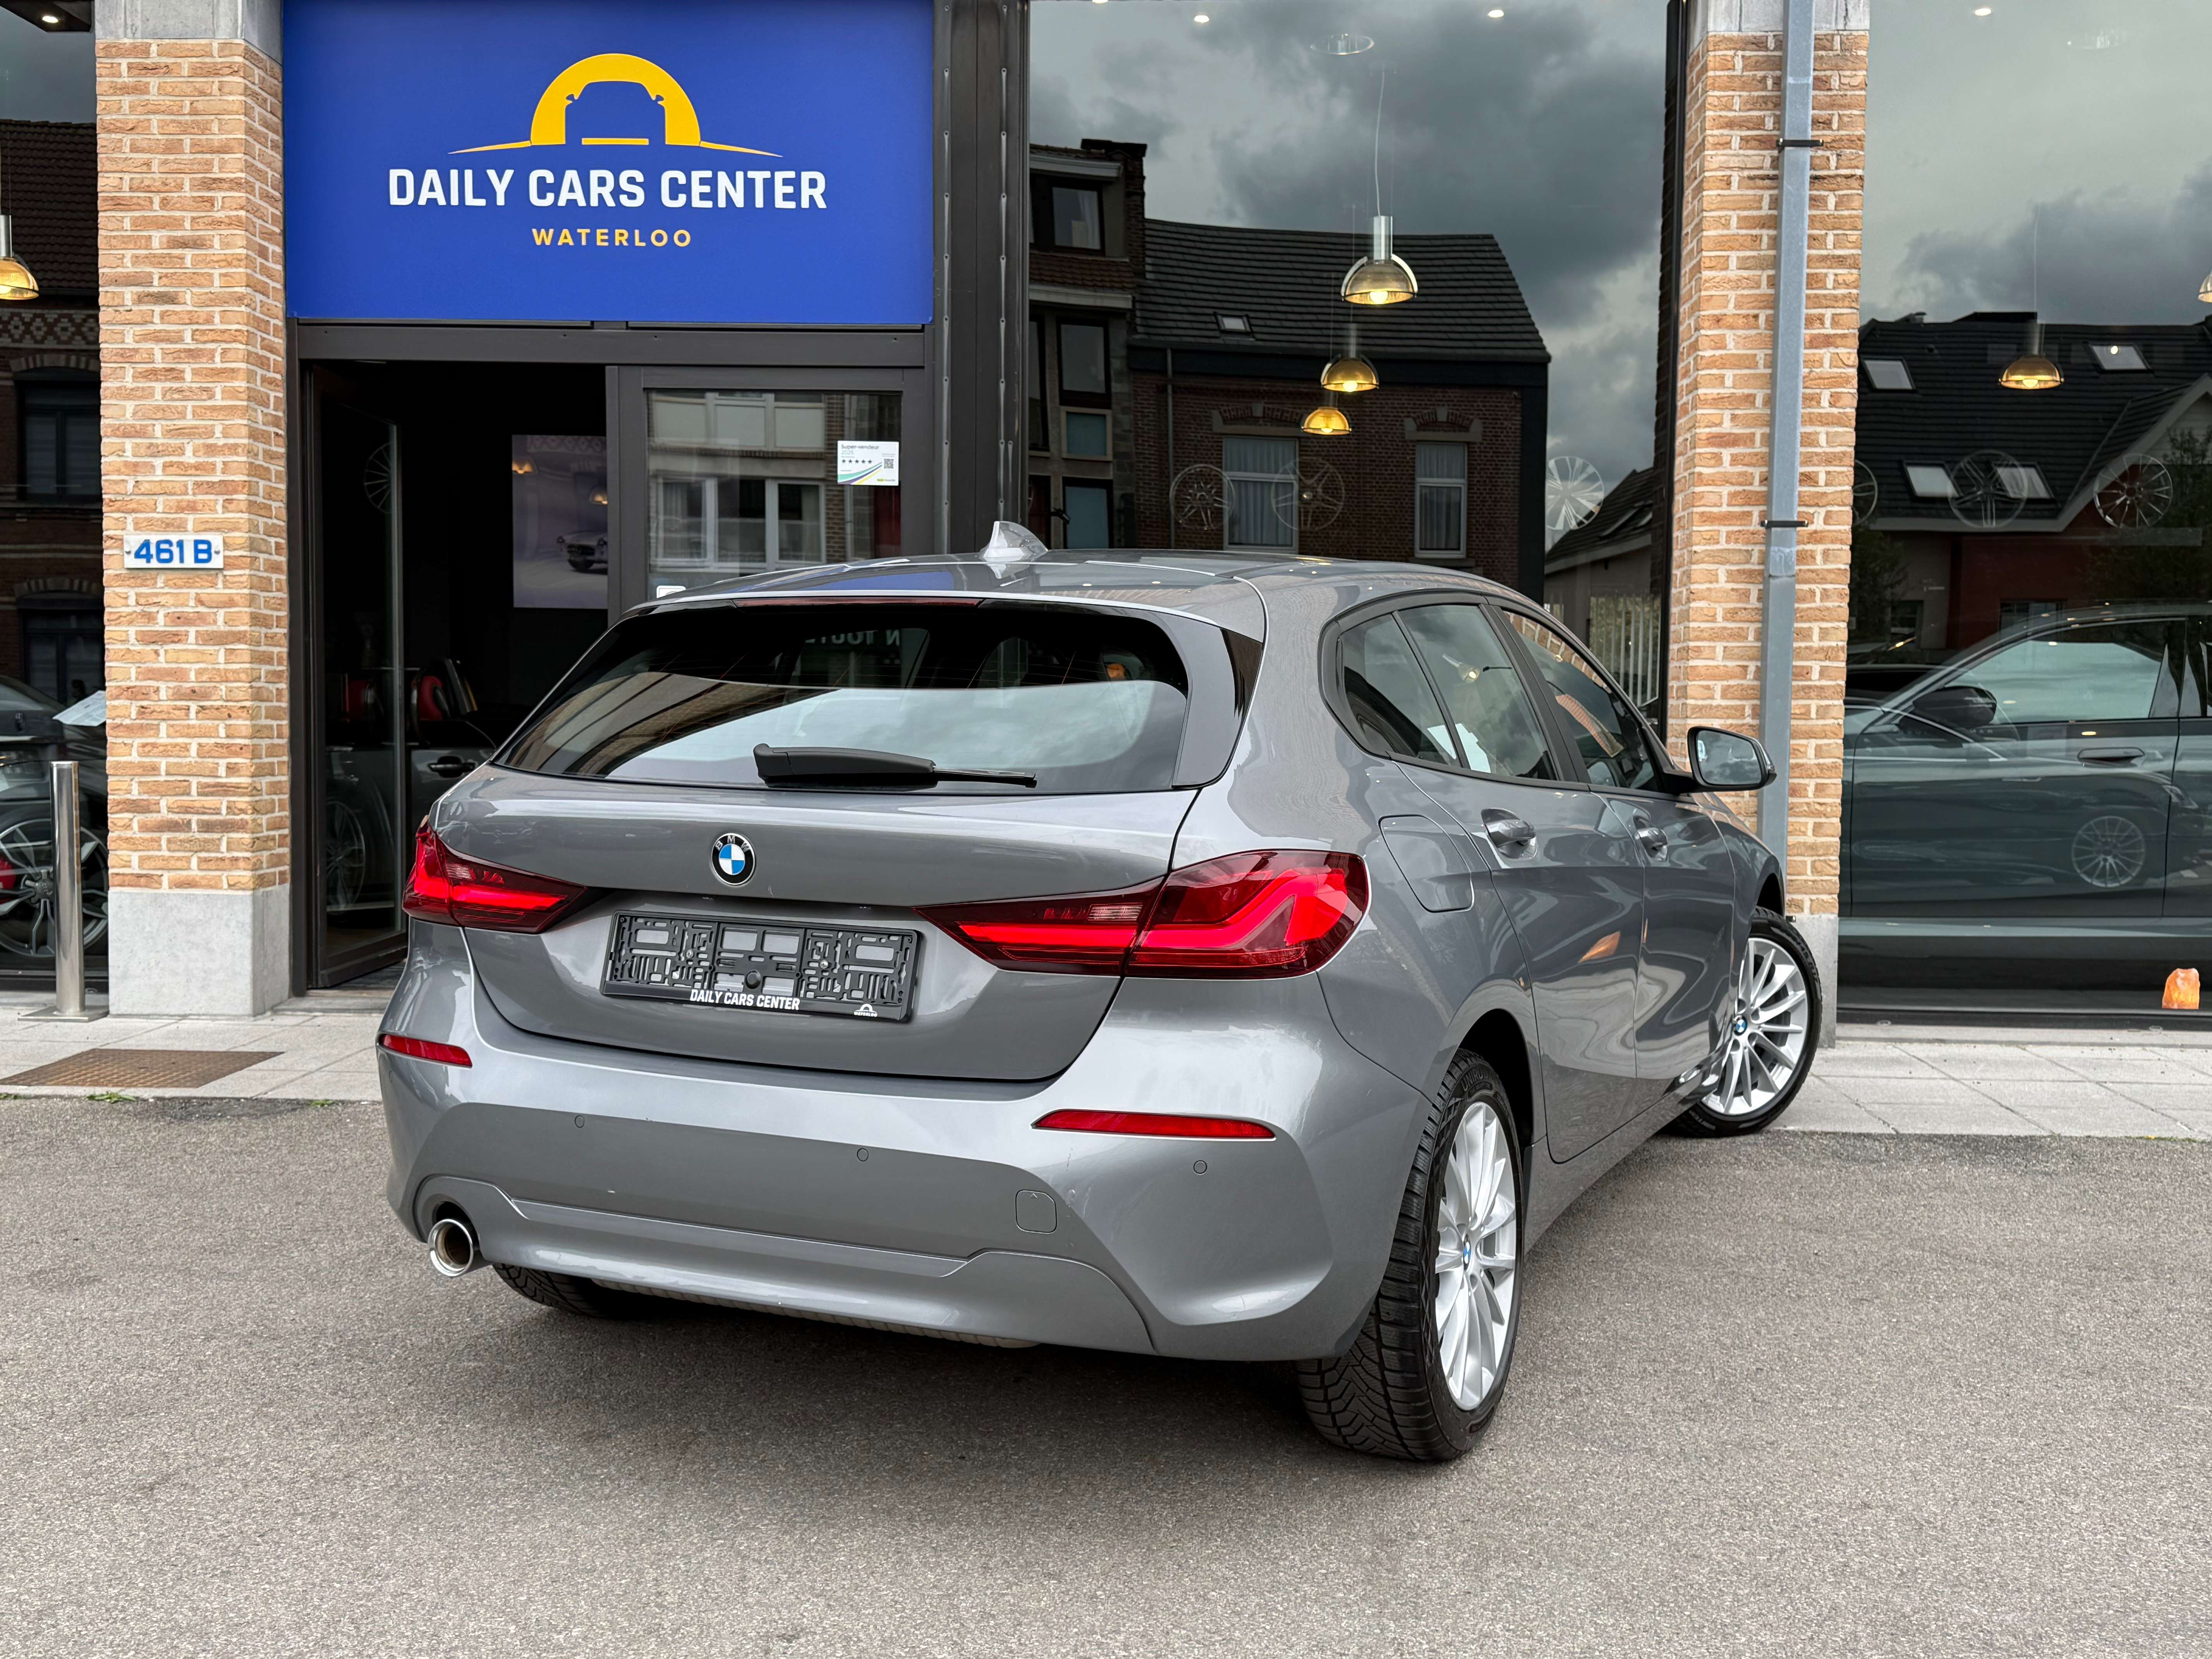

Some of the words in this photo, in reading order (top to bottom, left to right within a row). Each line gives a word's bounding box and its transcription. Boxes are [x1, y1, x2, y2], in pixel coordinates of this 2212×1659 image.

[389, 169, 515, 206] DAILY
[529, 169, 645, 207] CARS
[661, 170, 827, 209] CENTER
[532, 228, 691, 247] WATERLOO
[134, 539, 184, 564] 461
[193, 539, 212, 564] B
[714, 835, 751, 852] BMW
[690, 989, 723, 1003] DAILY
[724, 992, 754, 1006] CARS
[756, 995, 800, 1010] CENTER
